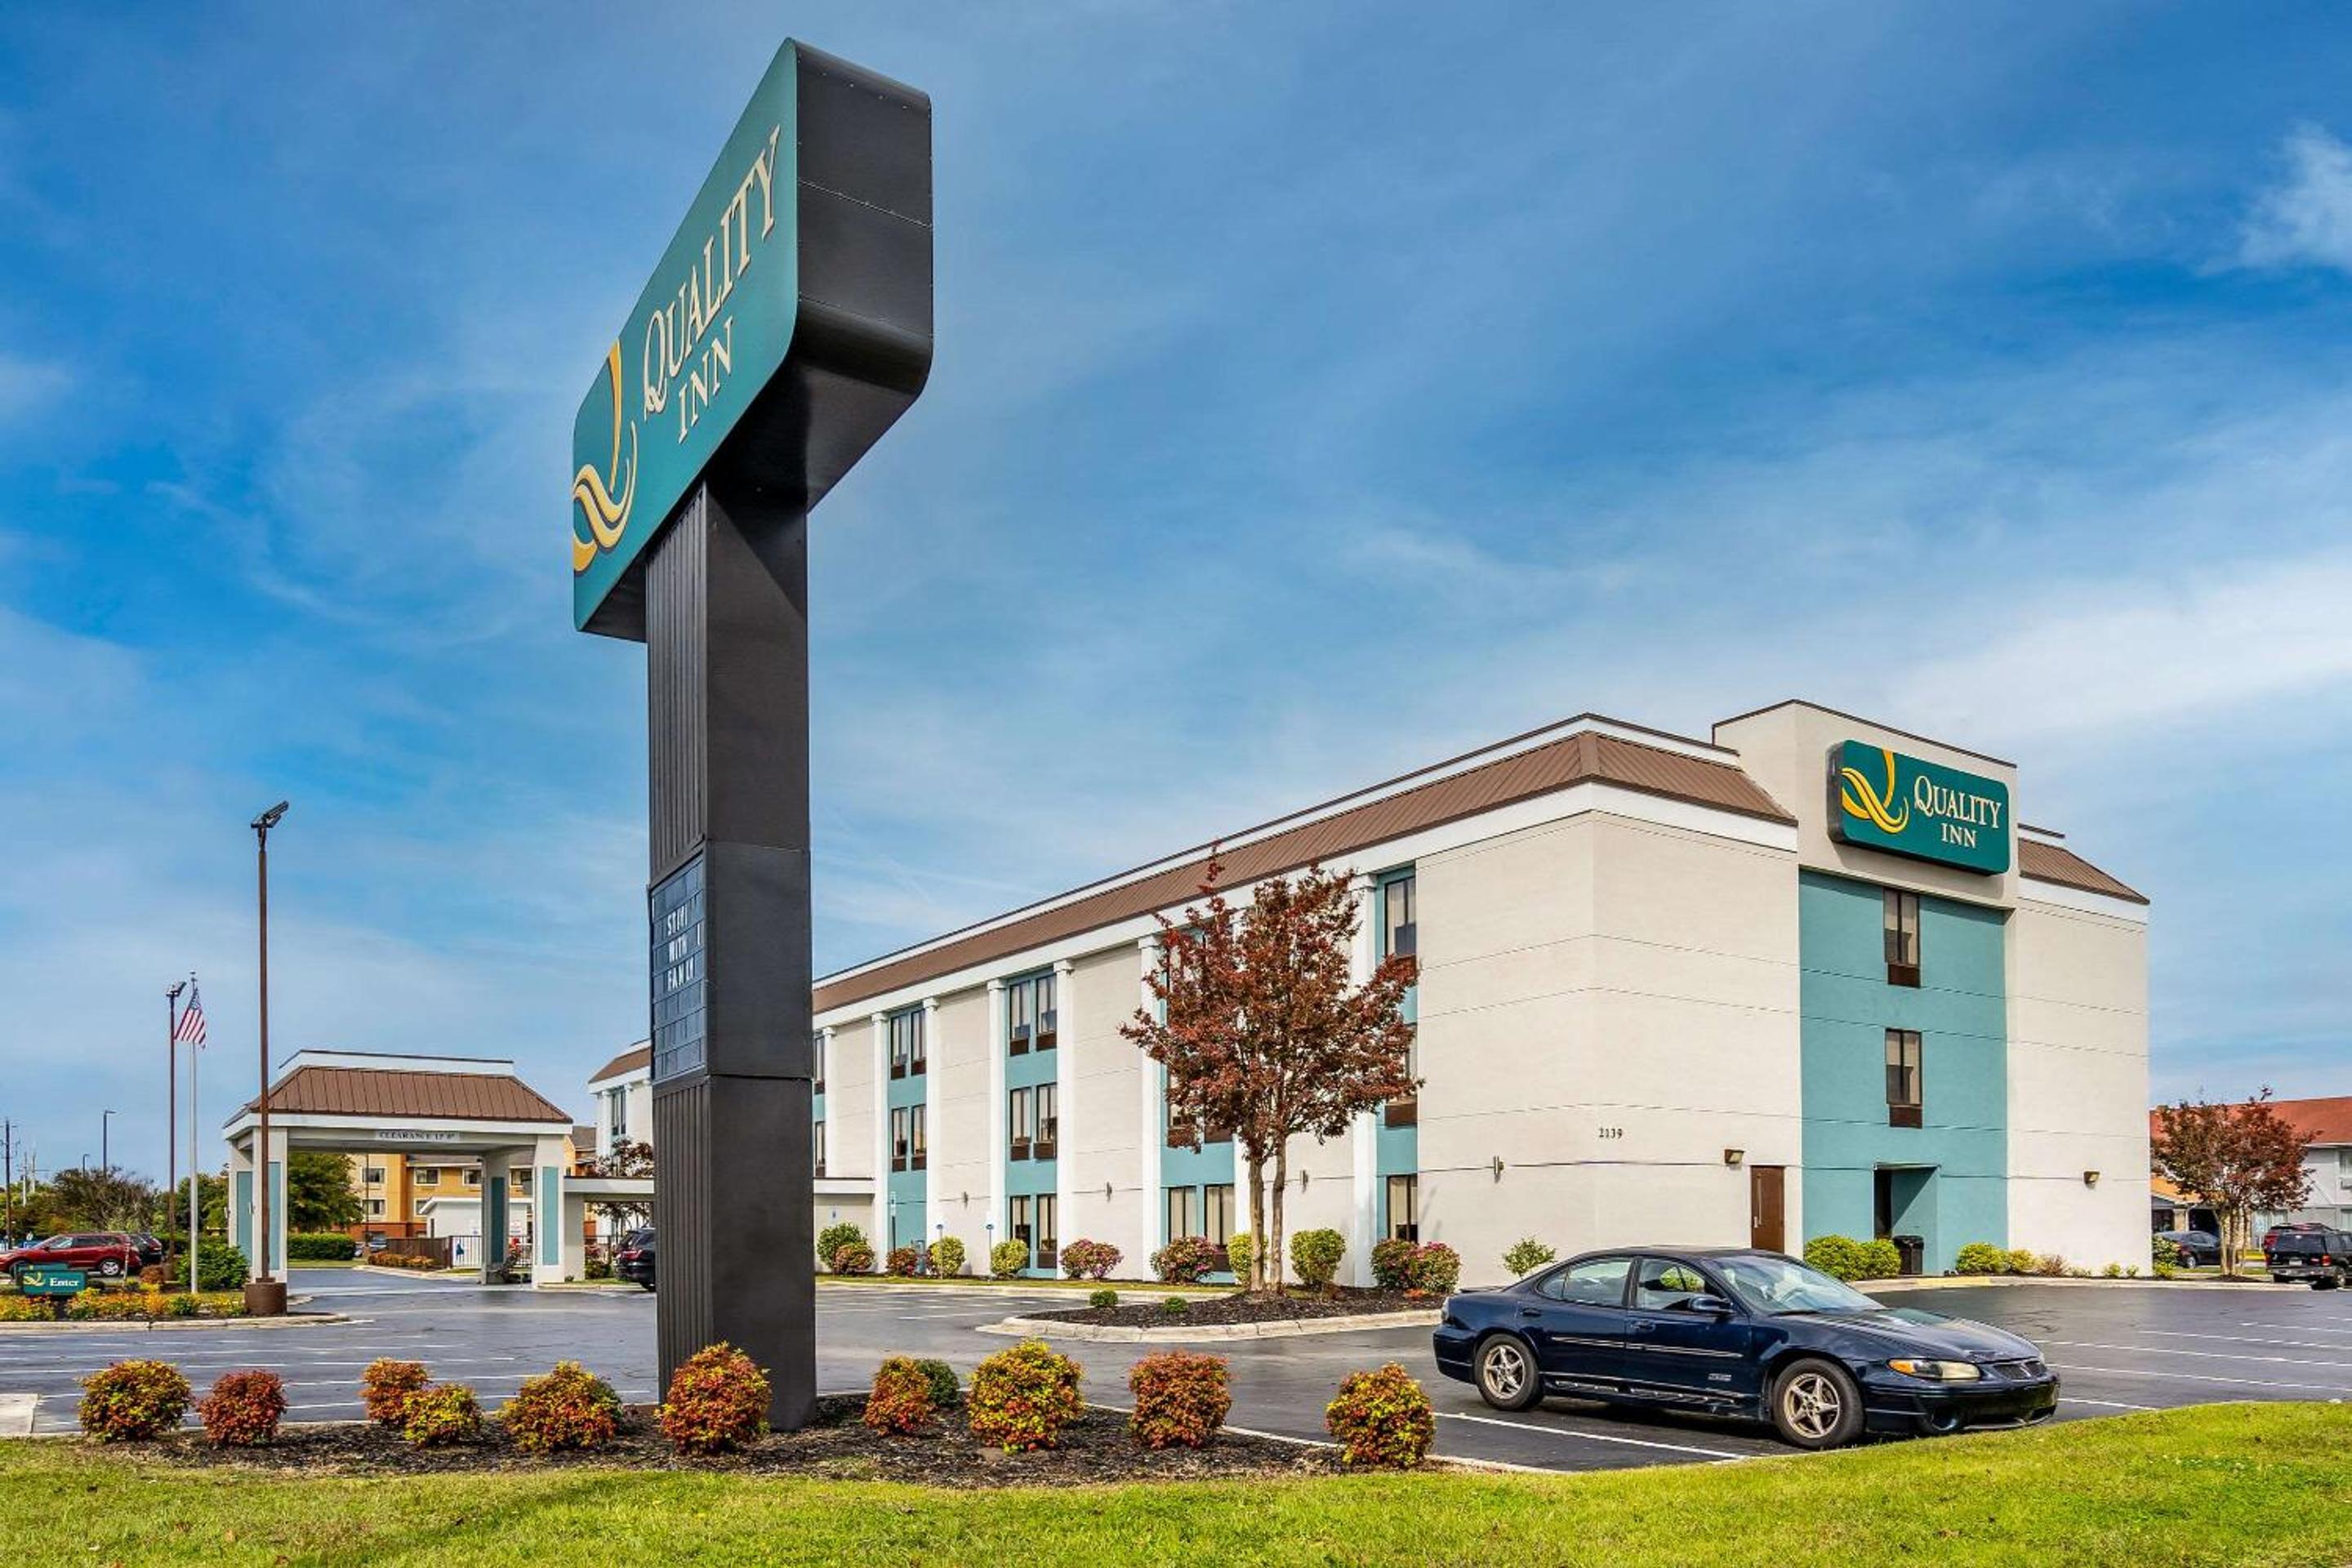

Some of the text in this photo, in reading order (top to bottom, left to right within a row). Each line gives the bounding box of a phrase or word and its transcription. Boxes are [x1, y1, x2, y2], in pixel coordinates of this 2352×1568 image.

[644, 123, 781, 421] QUALITY
[678, 315, 733, 444] INN
[1913, 775, 2002, 829] QUALITY
[1940, 822, 1977, 849] INN
[50, 1277, 79, 1287] Enter
